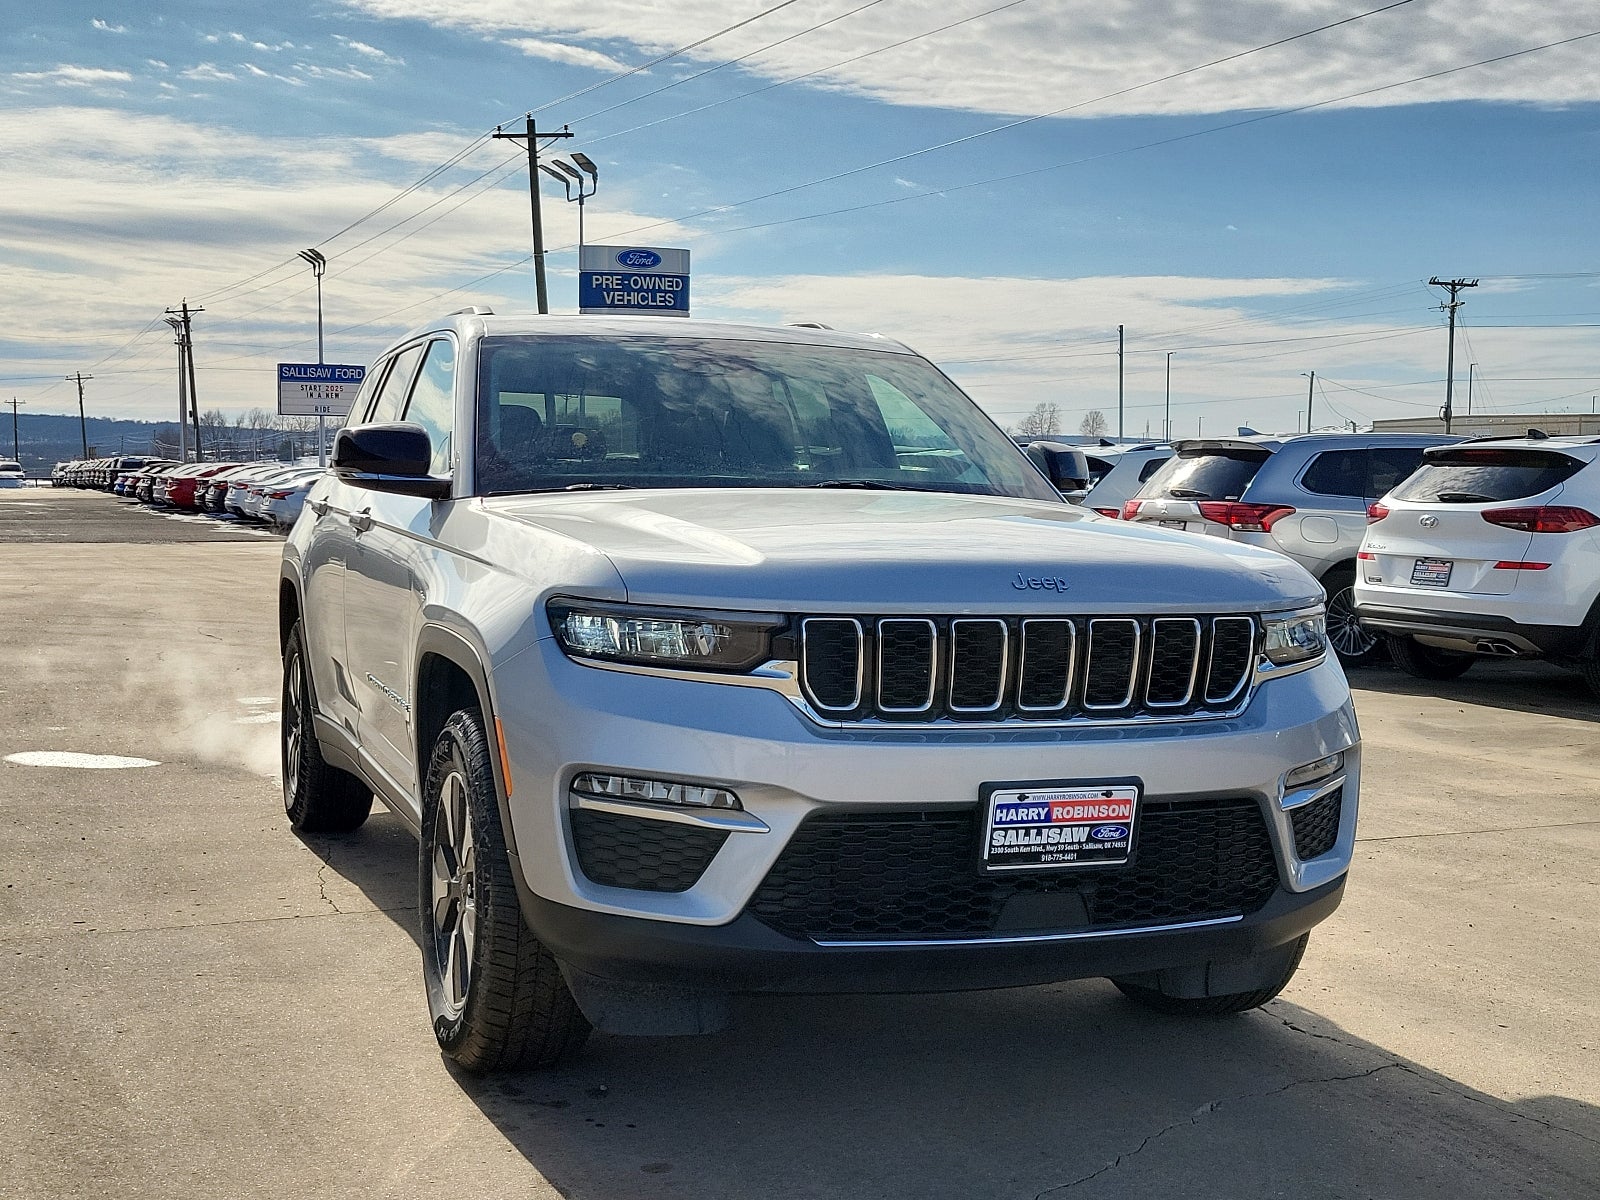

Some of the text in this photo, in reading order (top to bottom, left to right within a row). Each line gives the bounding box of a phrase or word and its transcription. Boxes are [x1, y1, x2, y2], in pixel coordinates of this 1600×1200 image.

[627, 252, 654, 265] Ford
[592, 275, 683, 291] PRE-OWNED
[603, 291, 675, 306] VEHICLES
[282, 366, 363, 379] SALLISAW FORD
[300, 384, 322, 392] START
[1012, 572, 1070, 593] Jeep
[1032, 792, 1099, 801] WWW.HARRYROBINSON.COM
[995, 804, 1131, 822] HARRY ROBINSON
[992, 827, 1090, 845] SALLISAW
[1097, 827, 1122, 838] Ford
